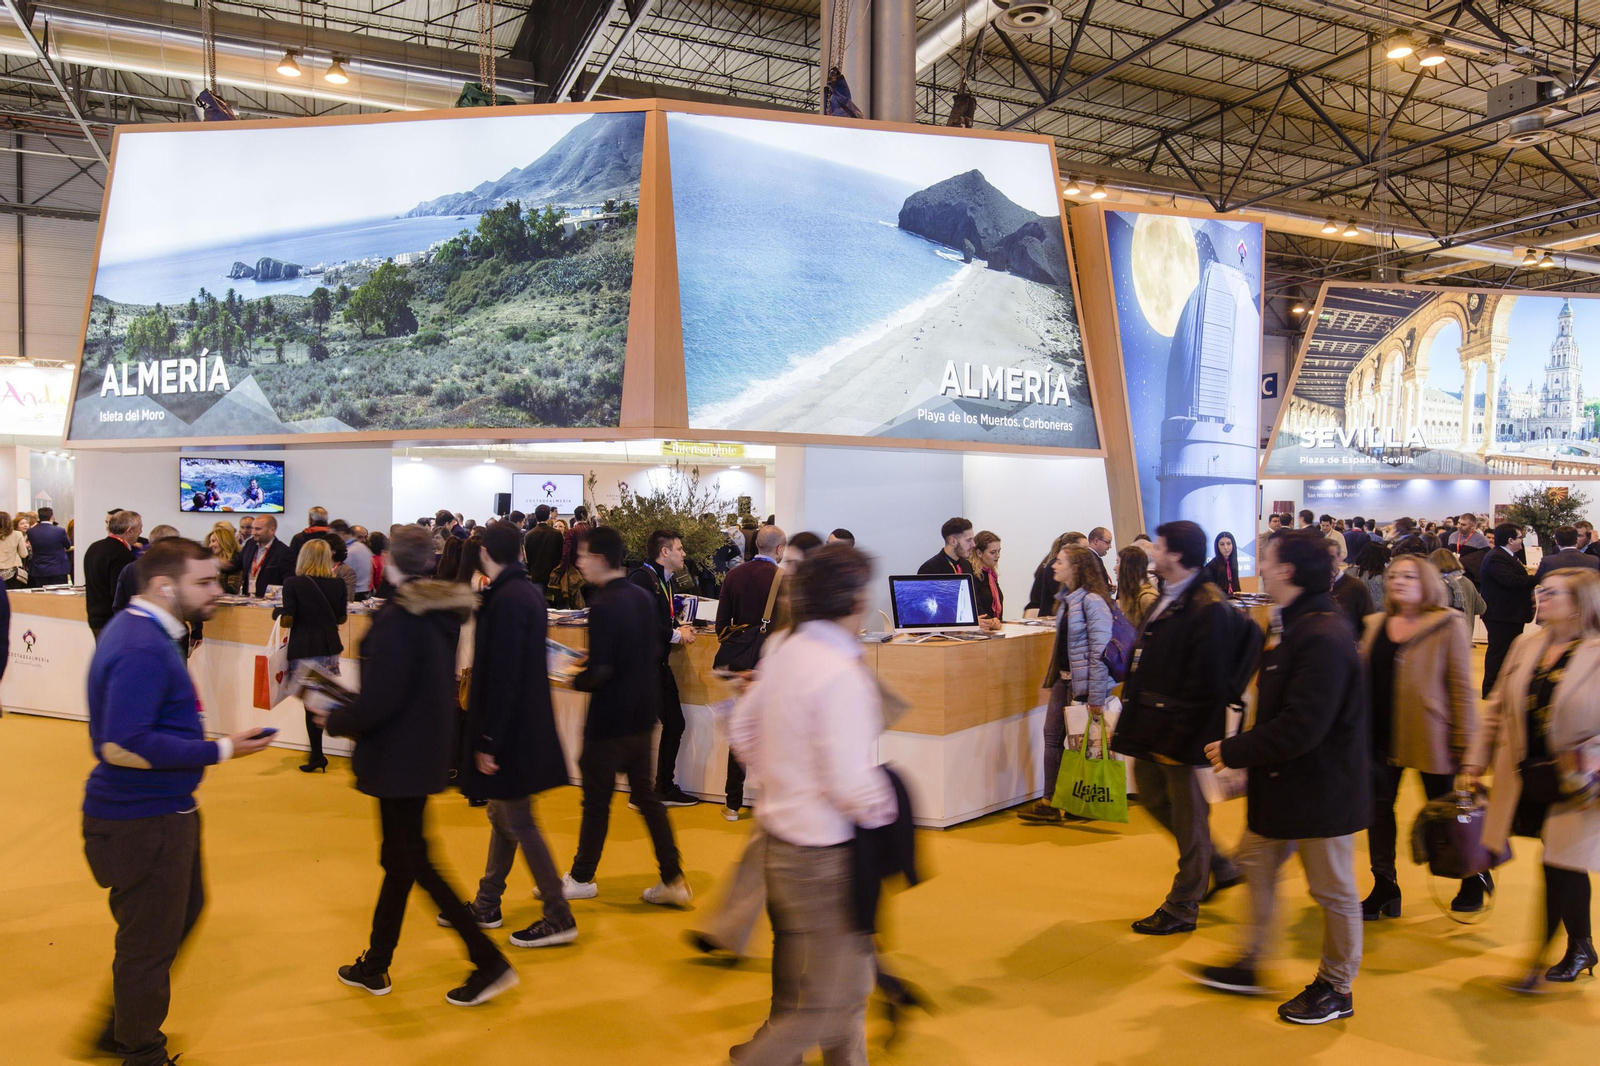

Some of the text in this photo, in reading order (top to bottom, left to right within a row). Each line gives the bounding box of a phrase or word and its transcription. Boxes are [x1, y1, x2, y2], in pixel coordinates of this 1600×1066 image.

[100, 347, 231, 397] ALMERÍA
[939, 360, 1072, 407] ALMERÍA
[1261, 376, 1273, 396] C
[100, 409, 165, 423] Isleta del Moro
[917, 408, 1074, 432] Playa de los Muertos. Carboneras
[1300, 426, 1427, 449] SEVILLA
[1299, 455, 1325, 465] Plaza
[1327, 455, 1340, 464] de
[1381, 455, 1414, 465] Sevilla
